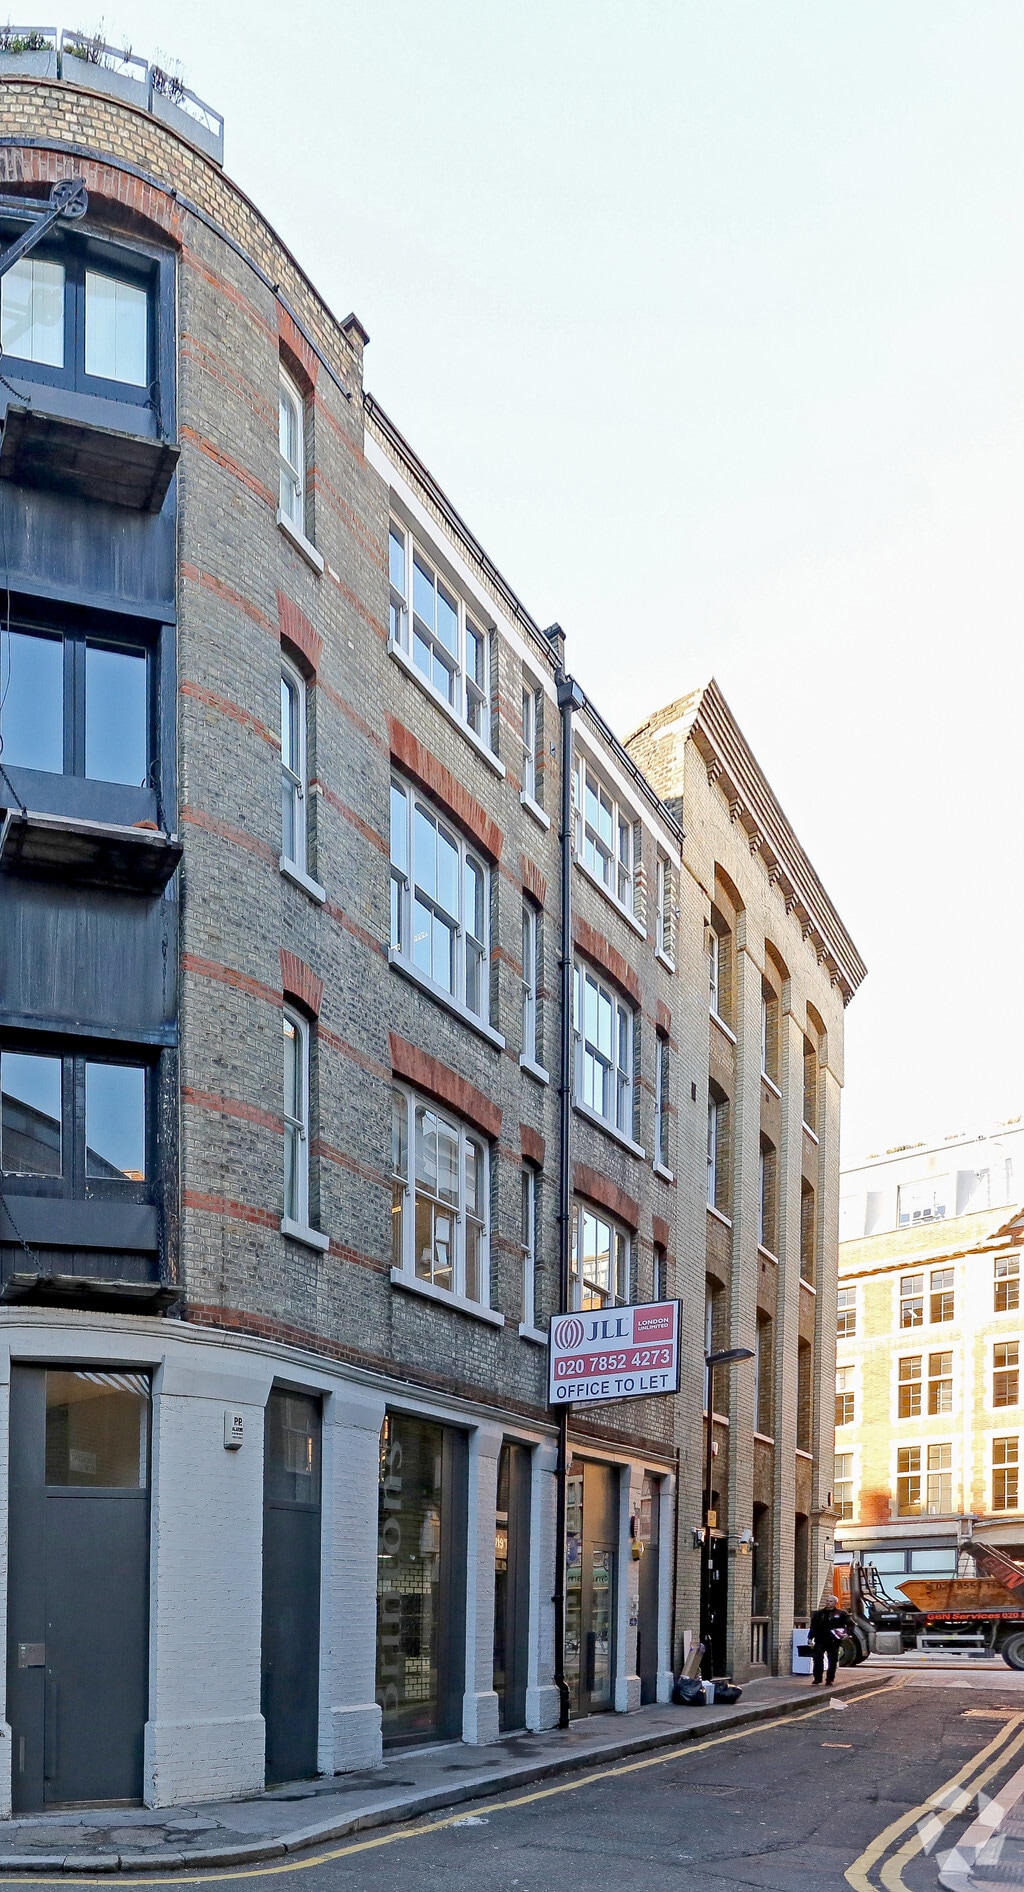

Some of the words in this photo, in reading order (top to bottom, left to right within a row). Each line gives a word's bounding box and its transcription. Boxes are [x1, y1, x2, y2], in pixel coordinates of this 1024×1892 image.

[637, 1317, 669, 1326] LONDON
[637, 1323, 669, 1331] UNLIMITED
[586, 1318, 630, 1342] JLL
[557, 1359, 585, 1376] 020
[589, 1354, 627, 1372] 7852
[631, 1349, 670, 1366] 4273
[556, 1381, 609, 1399] OFFICE
[615, 1378, 635, 1392] TO
[640, 1374, 669, 1390] LET
[952, 1612, 1001, 1620] Services
